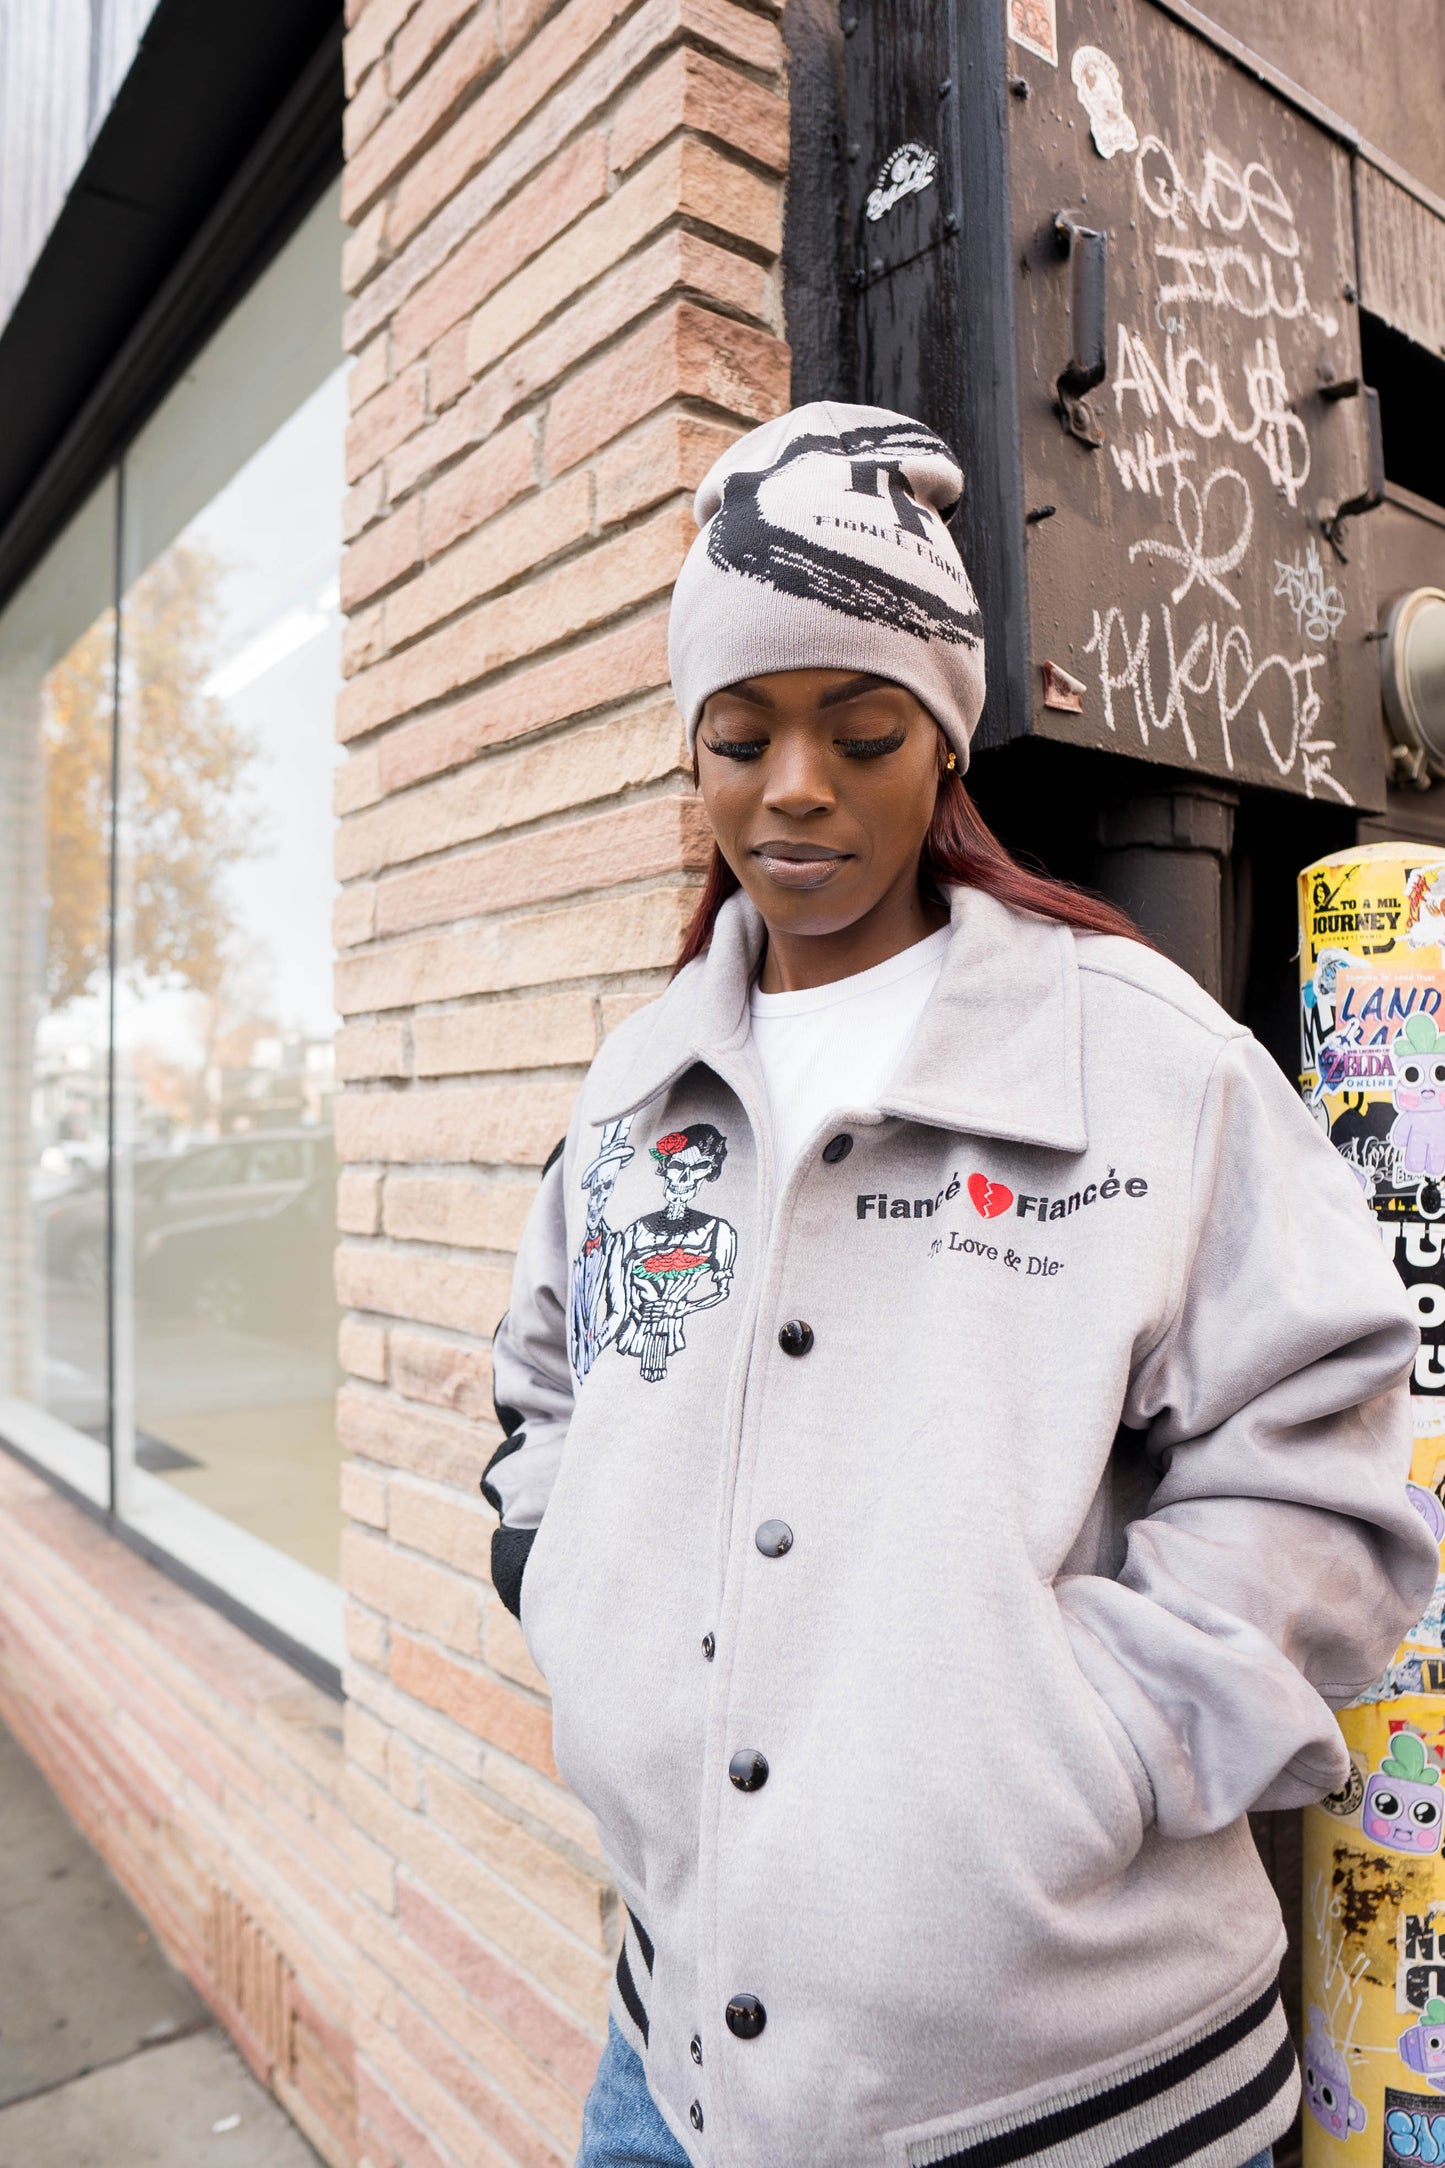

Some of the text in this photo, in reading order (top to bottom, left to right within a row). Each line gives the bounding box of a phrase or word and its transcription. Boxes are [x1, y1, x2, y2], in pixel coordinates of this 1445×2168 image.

[1340, 899, 1357, 910] TO
[1363, 899, 1371, 909] A
[1312, 912, 1402, 935] JOURNEY
[1340, 986, 1443, 1022] LAND
[1323, 1051, 1397, 1083] ZELDA
[1346, 1079, 1393, 1088] ONLINE
[1016, 1168, 1148, 1222] Fiancée
[948, 1231, 998, 1260] Love
[1004, 1248, 1021, 1271] &
